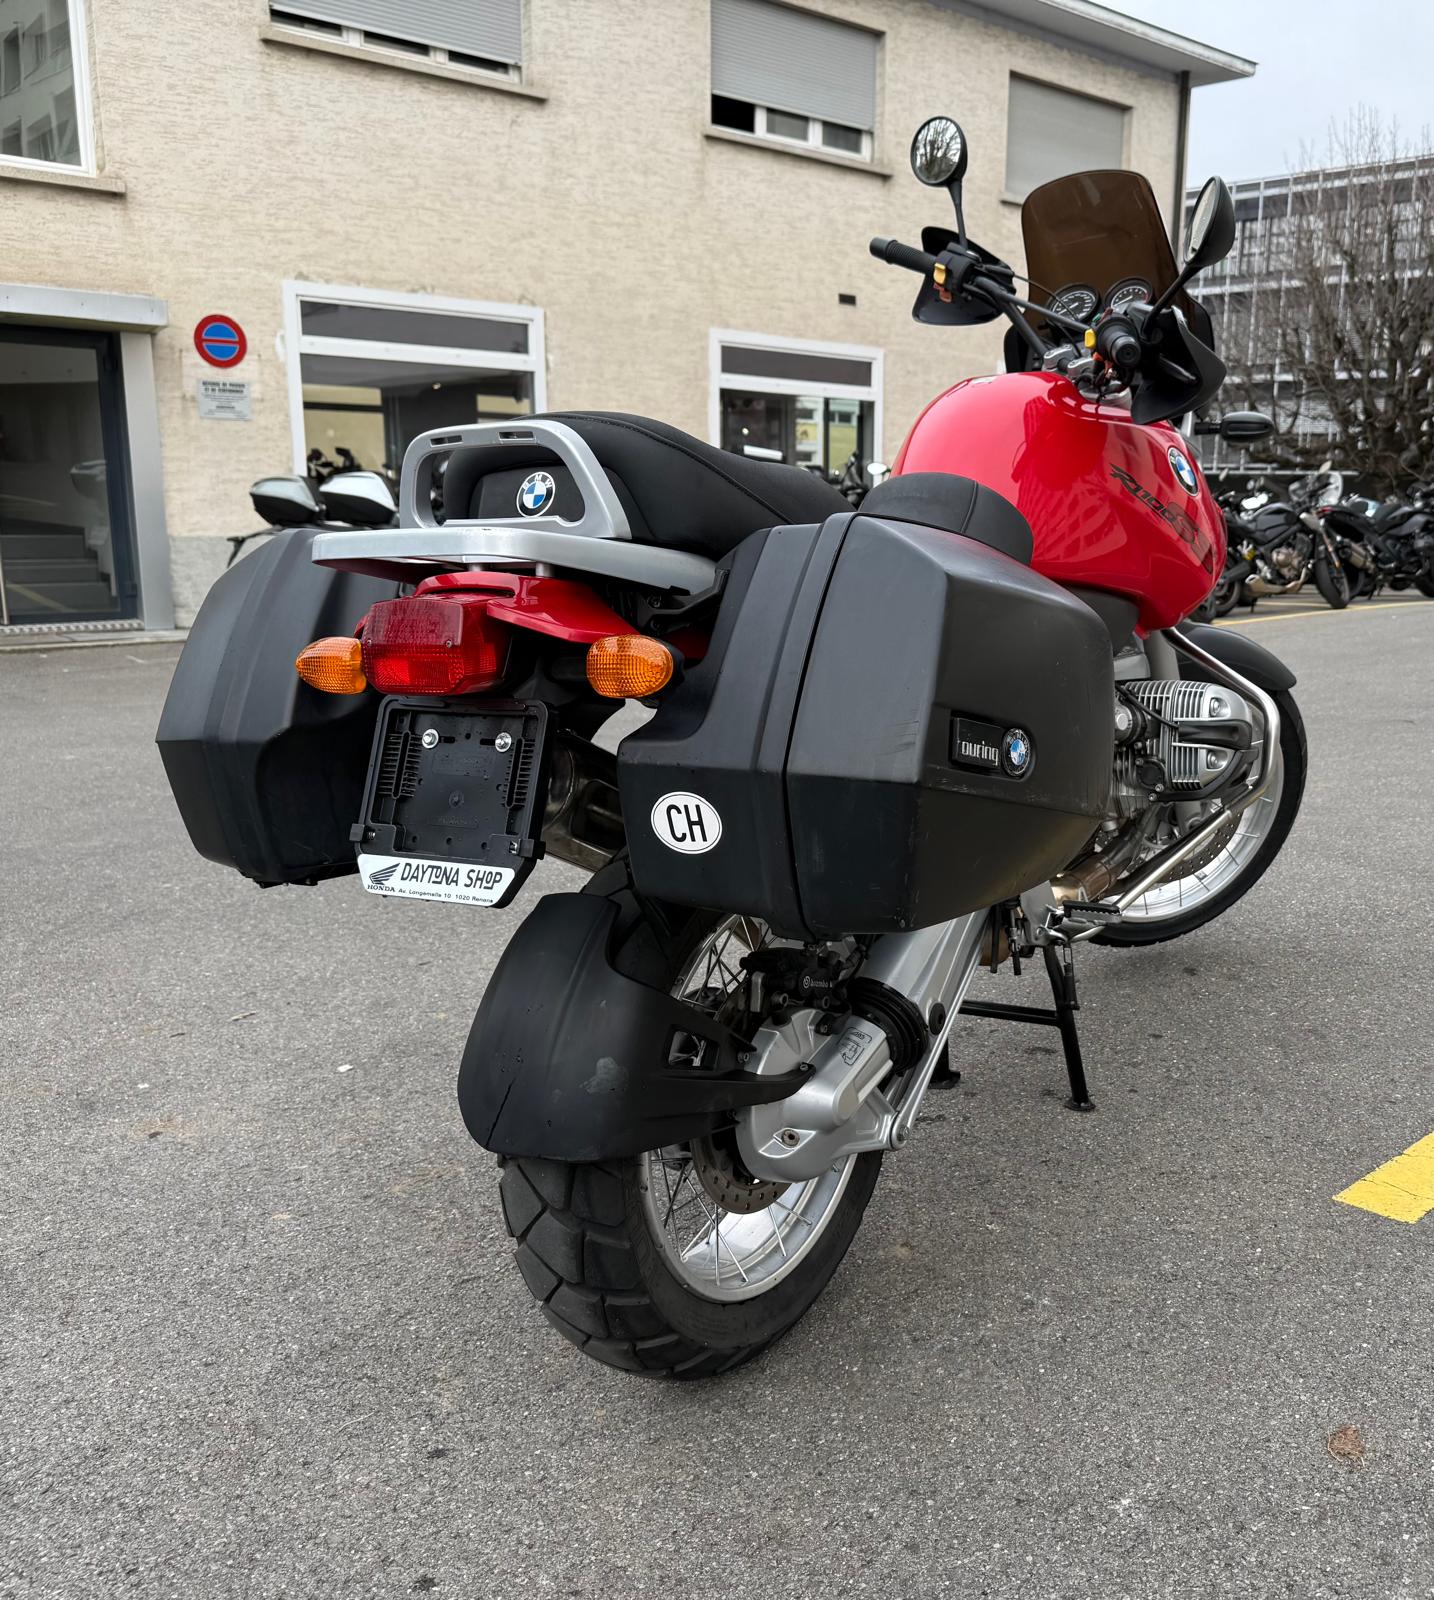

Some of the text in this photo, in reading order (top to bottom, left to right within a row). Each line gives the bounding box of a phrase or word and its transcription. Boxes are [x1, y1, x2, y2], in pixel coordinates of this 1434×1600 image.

[665, 804, 708, 842] CH
[366, 884, 396, 893] HONDA
[400, 862, 503, 890] DAYTONA SHOP
